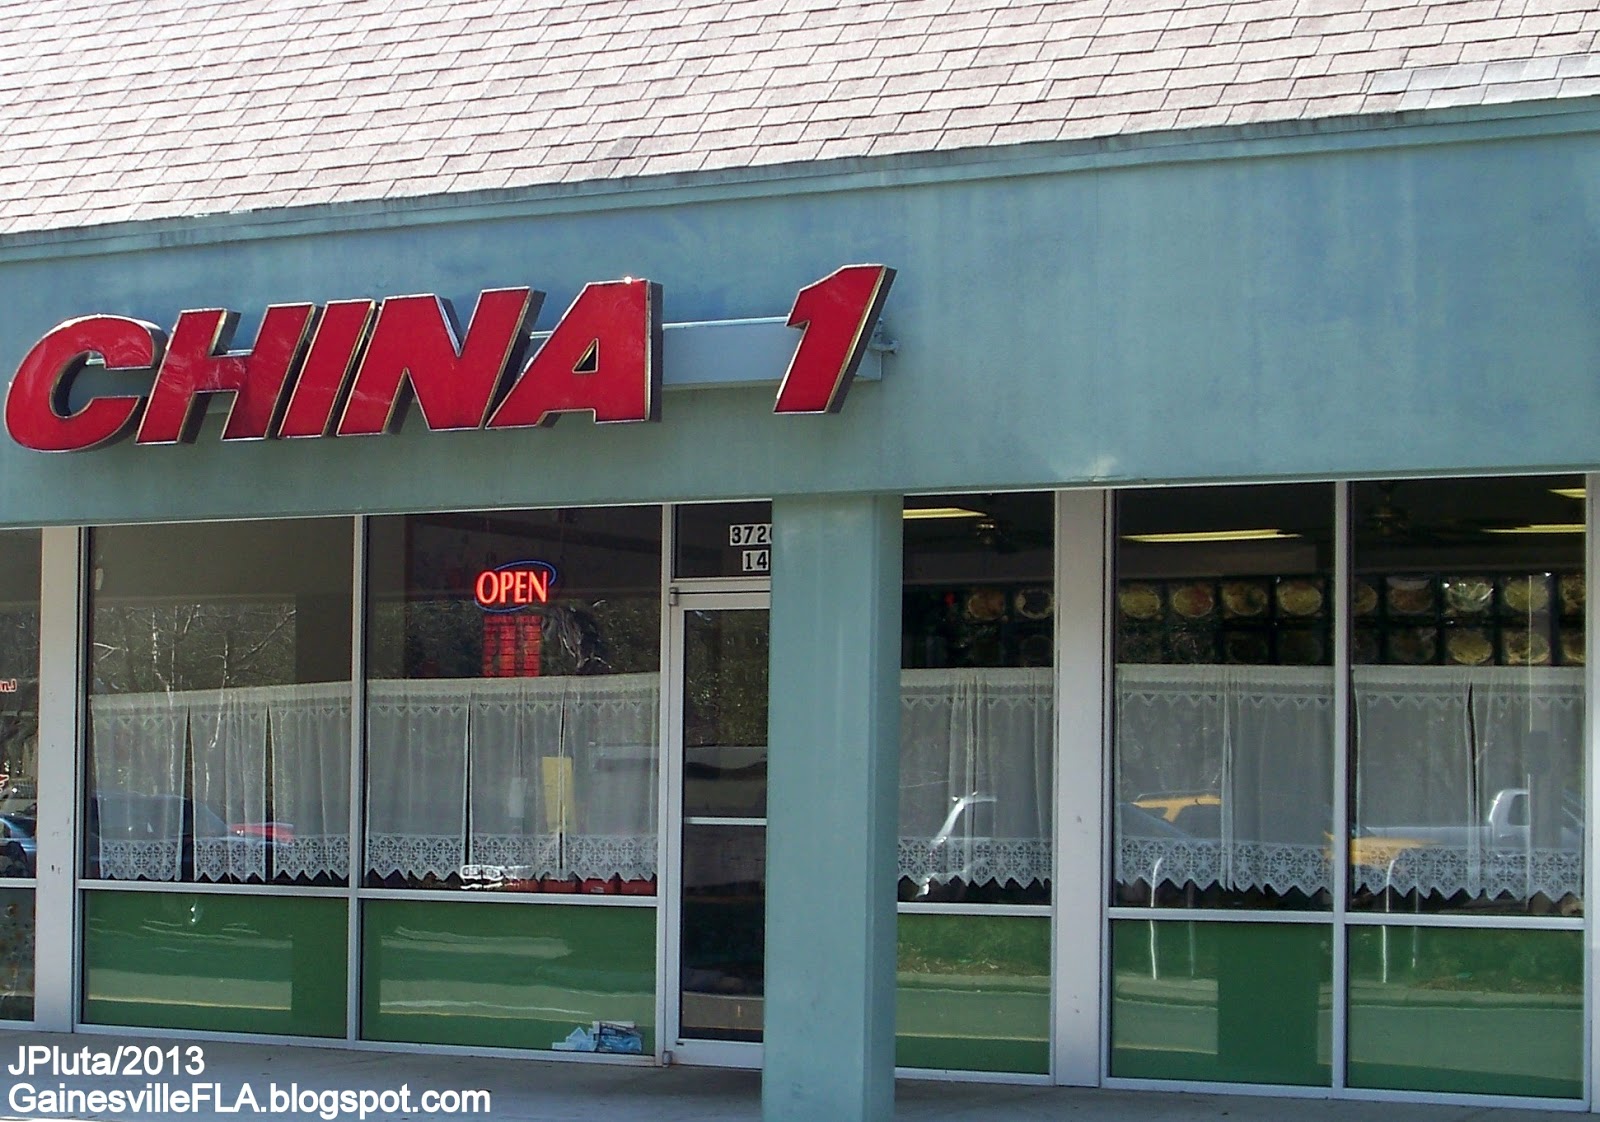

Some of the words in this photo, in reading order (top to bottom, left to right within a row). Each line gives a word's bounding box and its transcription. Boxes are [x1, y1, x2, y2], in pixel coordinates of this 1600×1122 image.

[5, 277, 660, 453] CHINA
[775, 263, 893, 414] 1
[744, 551, 768, 570] 14
[475, 569, 551, 606] OPEN
